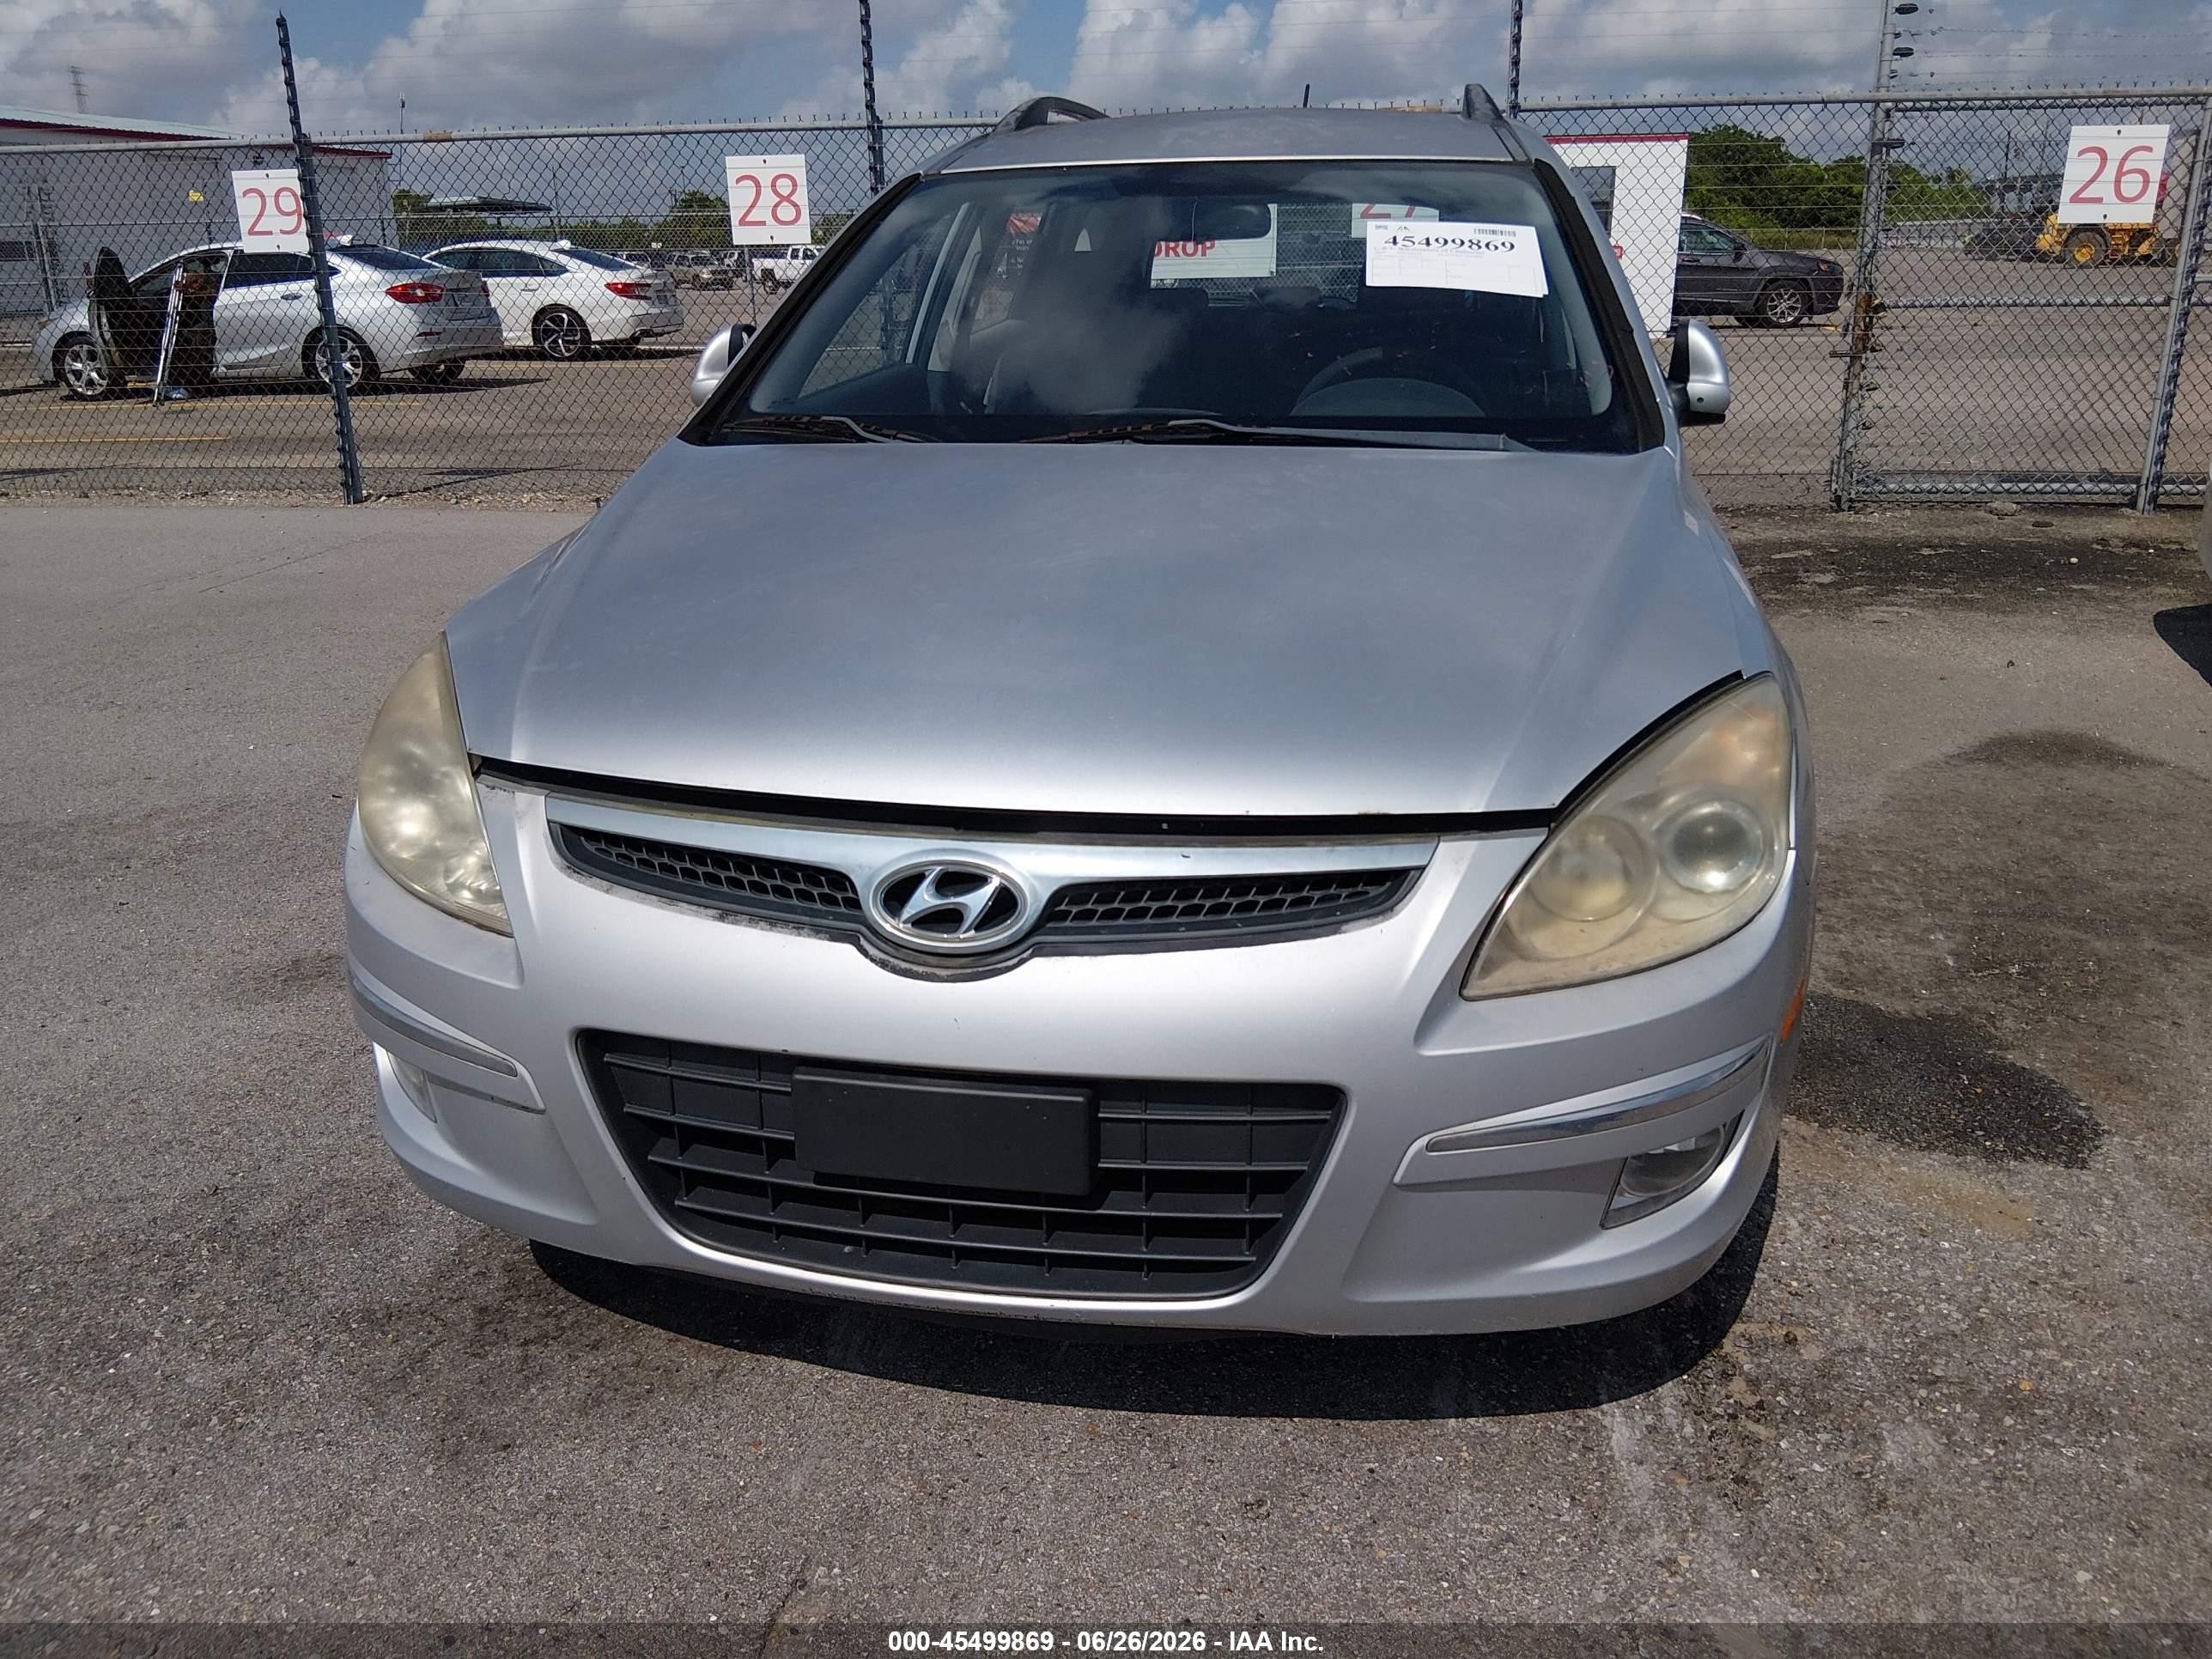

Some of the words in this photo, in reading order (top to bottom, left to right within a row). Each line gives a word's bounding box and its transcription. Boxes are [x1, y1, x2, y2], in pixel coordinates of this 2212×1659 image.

[735, 173, 802, 227] 28
[2069, 145, 2154, 204] 26
[242, 186, 302, 236] 29
[1384, 234, 1516, 253] 45499869
